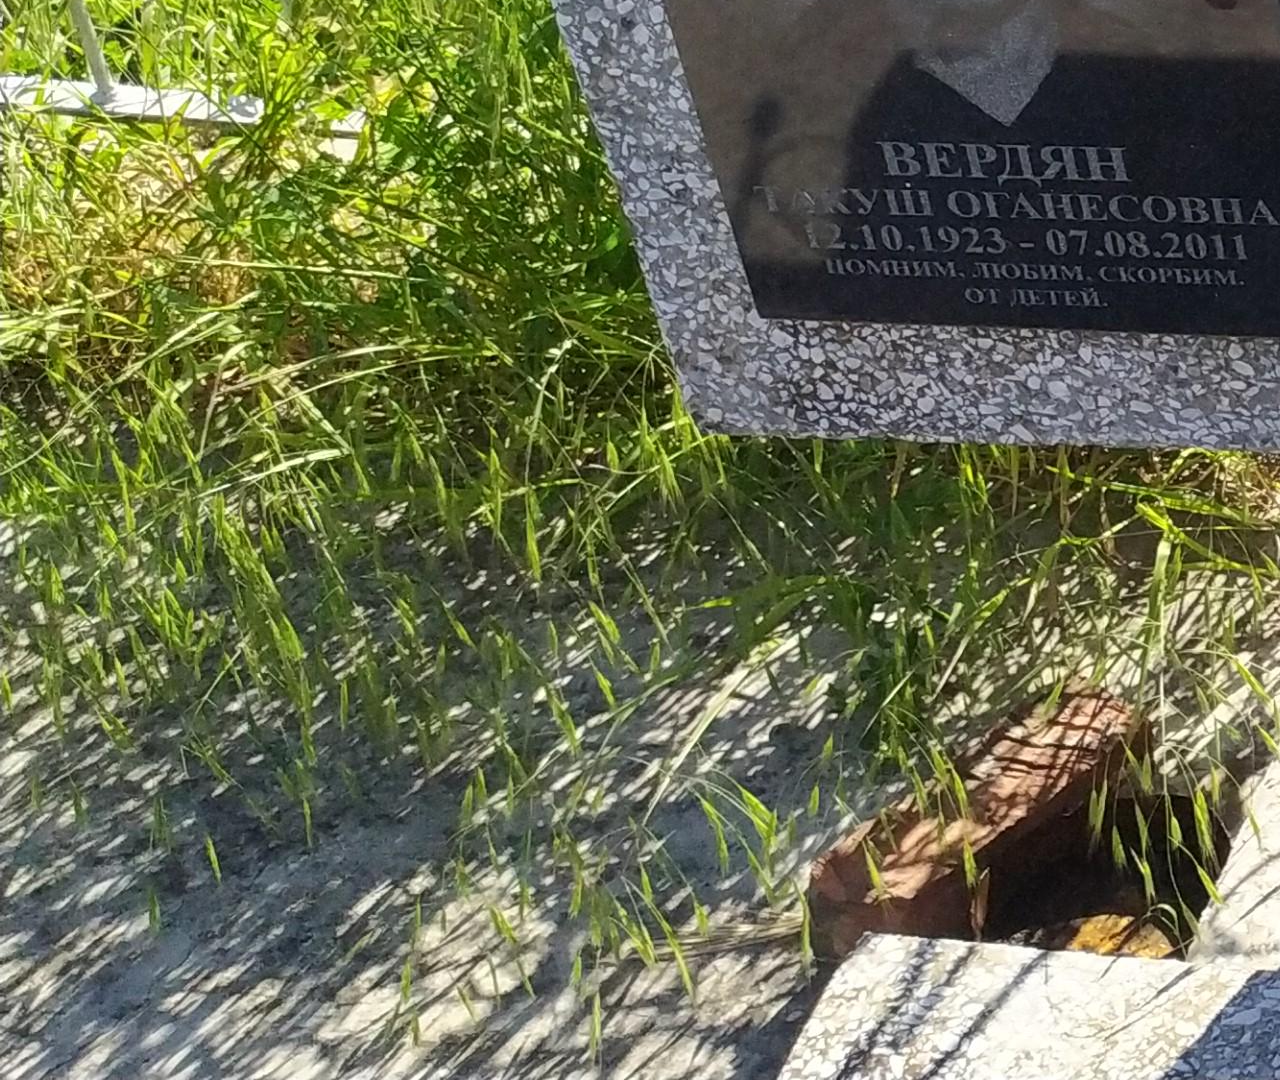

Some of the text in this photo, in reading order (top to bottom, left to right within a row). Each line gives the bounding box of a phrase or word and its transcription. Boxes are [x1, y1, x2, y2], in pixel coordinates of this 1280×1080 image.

[874, 140, 1133, 188] ВЕРДЯН
[946, 189, 1280, 227] ОГАНЕСОВНА
[804, 220, 1009, 255] 12.10.1923
[1045, 228, 1248, 261] 07.08.2011
[963, 287, 999, 305] ОТ
